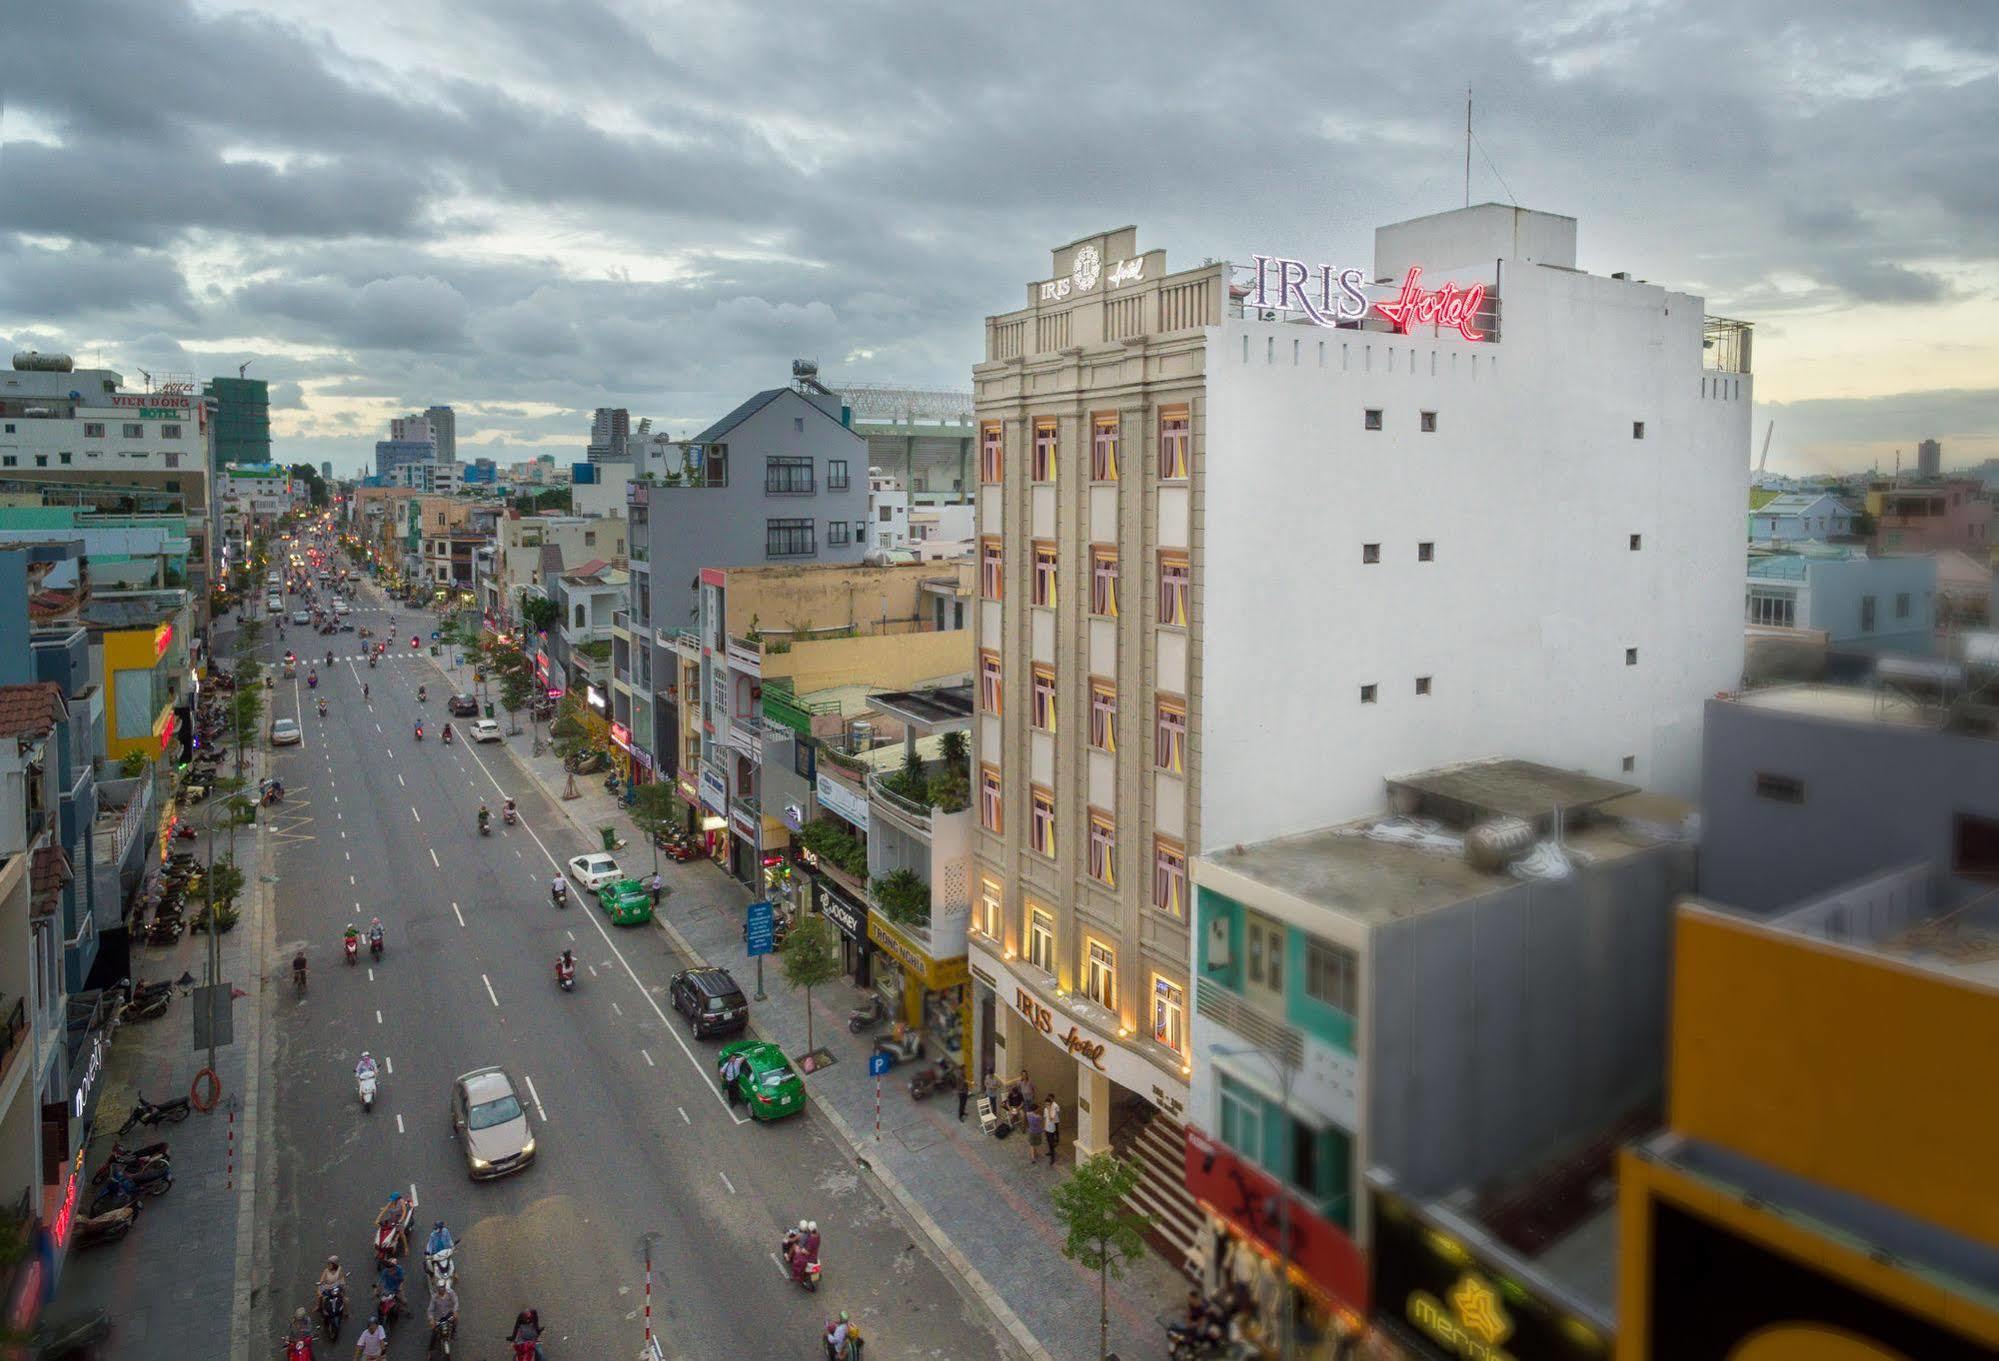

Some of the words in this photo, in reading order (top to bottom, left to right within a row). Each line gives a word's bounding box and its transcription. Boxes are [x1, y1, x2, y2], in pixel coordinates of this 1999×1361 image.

[1040, 278, 1071, 300] IRIS
[1251, 254, 1369, 328] IRIS
[1376, 266, 1484, 341] Hotel
[829, 902, 858, 931] JOCKEY
[1016, 987, 1053, 1034] IRIS
[875, 1058, 884, 1073] P
[1415, 1297, 1504, 1361] merri
